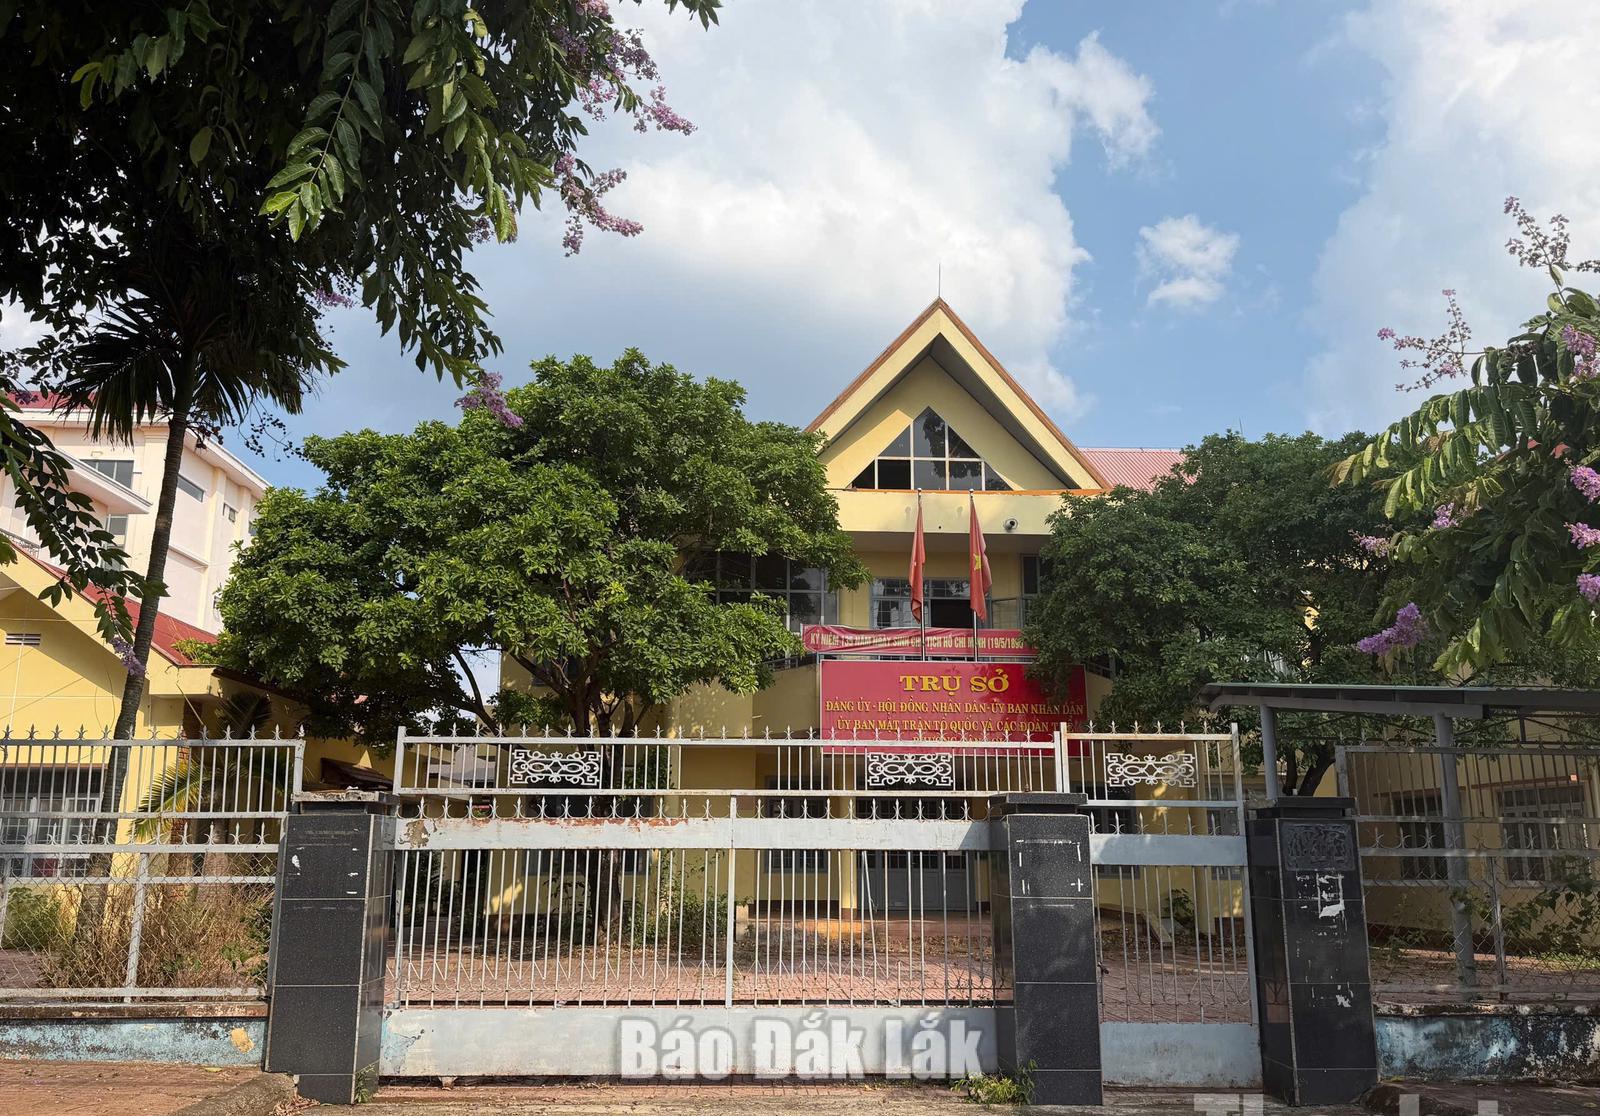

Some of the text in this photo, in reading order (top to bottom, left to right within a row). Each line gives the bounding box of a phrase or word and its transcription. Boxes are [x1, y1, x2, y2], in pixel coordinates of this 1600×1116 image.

[927, 636, 942, 650] TỊCH
[899, 668, 1009, 696] TRỤ SỞ
[826, 697, 854, 712] ĐẢNG
[857, 697, 871, 712] ỦY
[878, 697, 897, 715] HỘI
[900, 695, 929, 713] ĐỒNG
[932, 699, 961, 713] NHÂN
[1007, 703, 1029, 714] BAN
[837, 715, 852, 730] ỦY
[854, 719, 876, 731] BAN
[949, 715, 979, 733] QUỐC
[980, 717, 993, 731] VÀ
[996, 717, 1017, 732] CÁC
[1019, 718, 1049, 732] ĐOÀN
